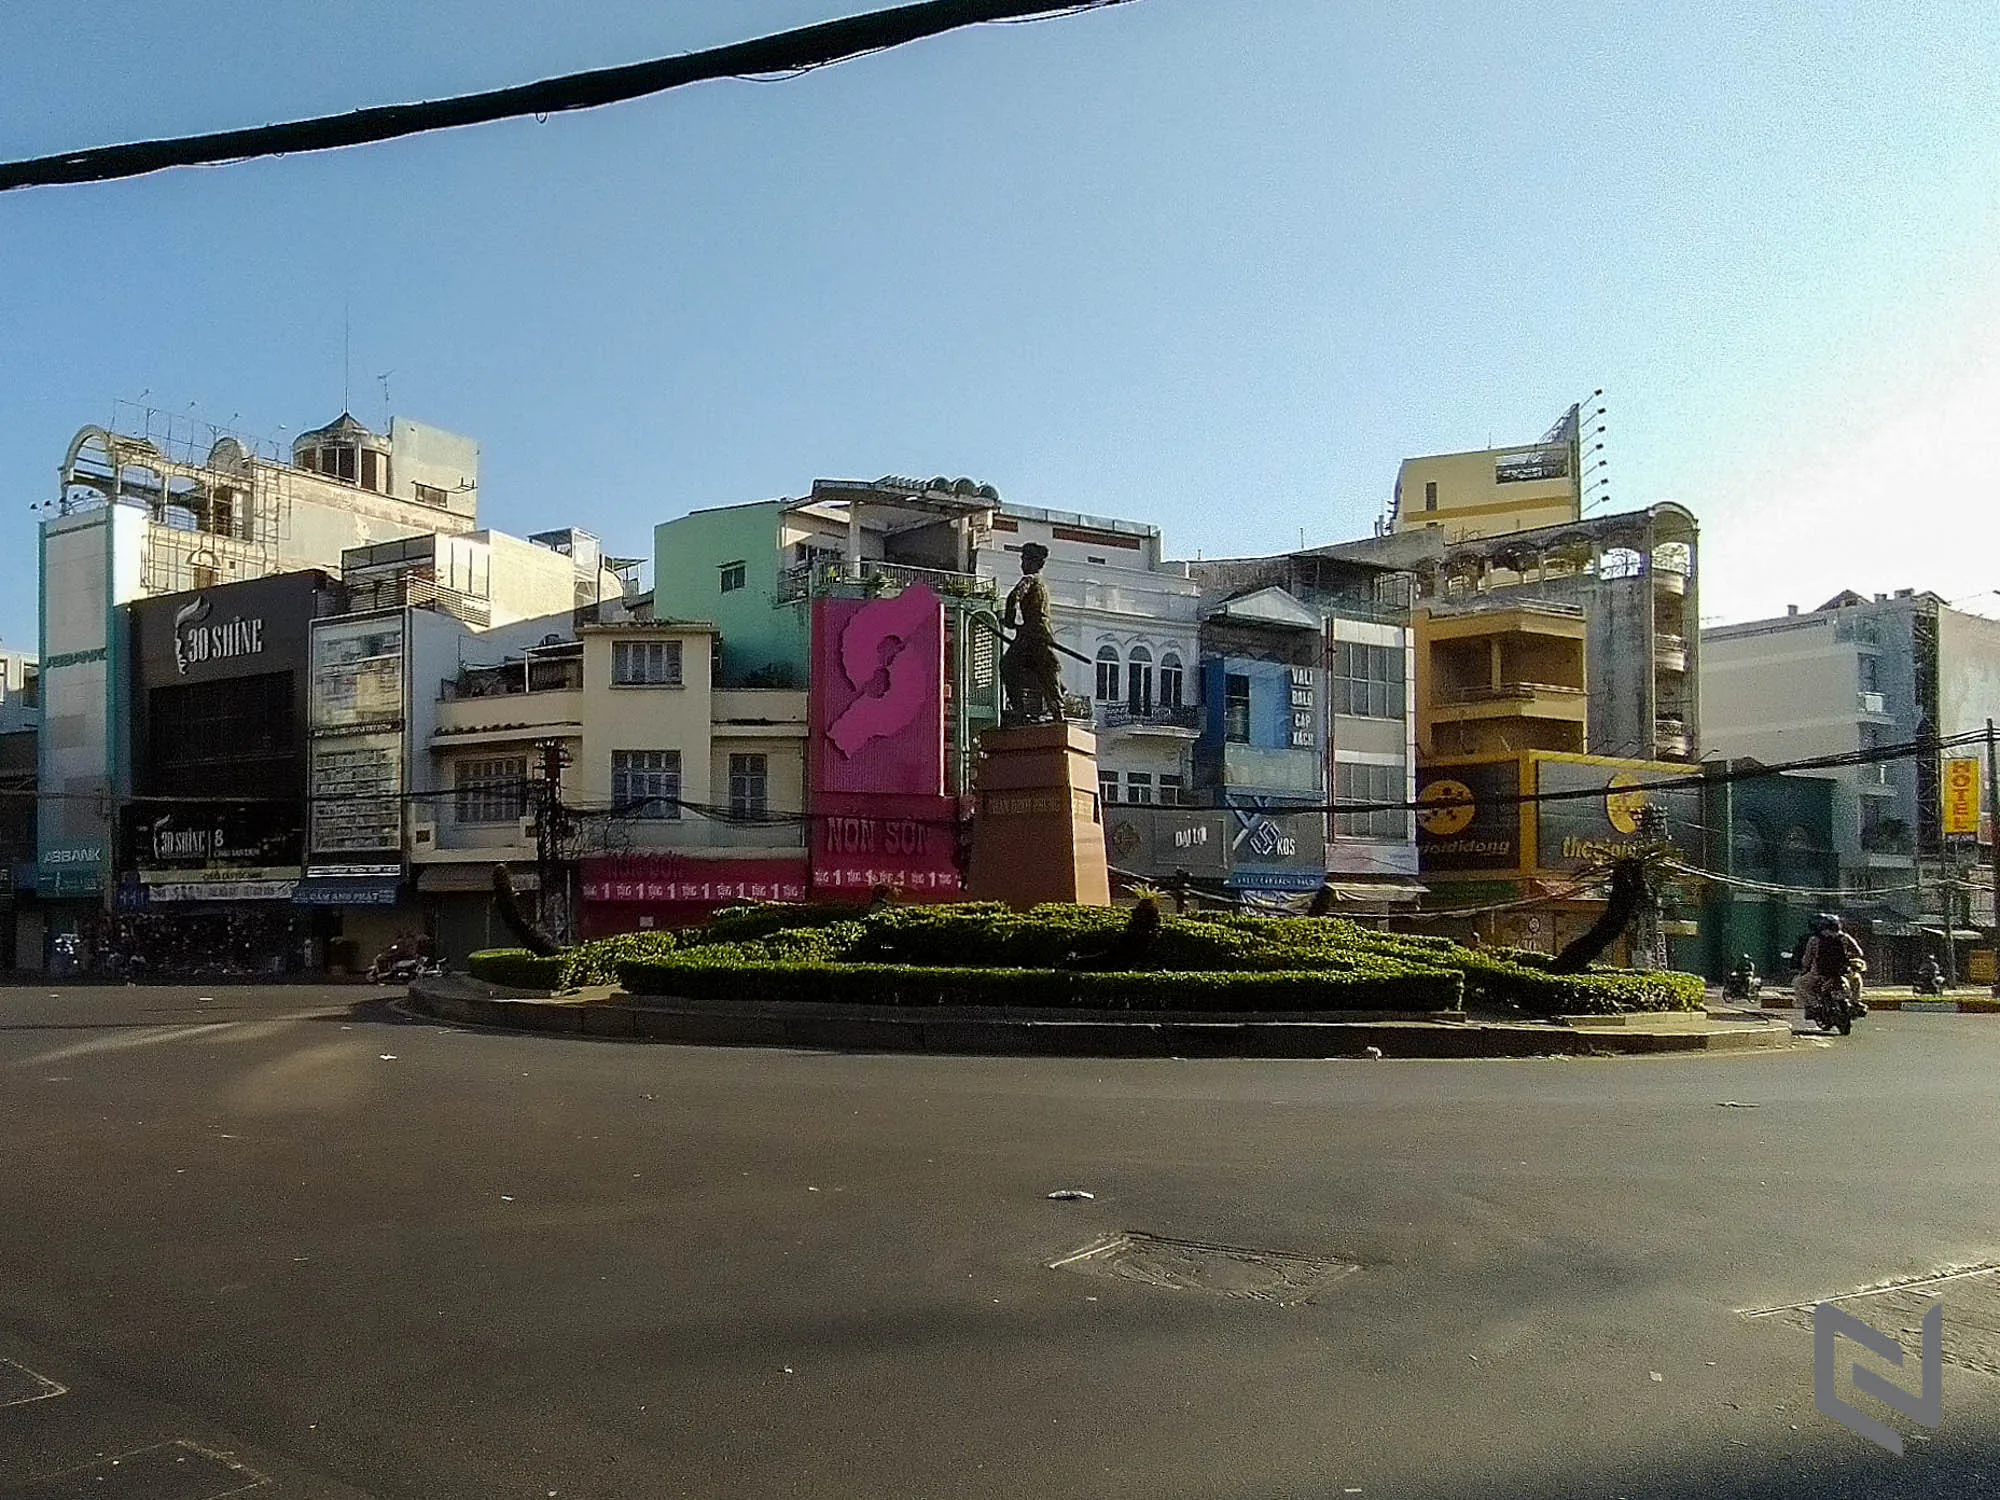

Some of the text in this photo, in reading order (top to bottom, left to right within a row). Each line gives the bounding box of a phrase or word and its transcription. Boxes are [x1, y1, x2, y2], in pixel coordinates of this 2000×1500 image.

[1291, 667, 1313, 685] VALI
[1951, 760, 1971, 829] HOTEL
[1277, 837, 1296, 855] KOS
